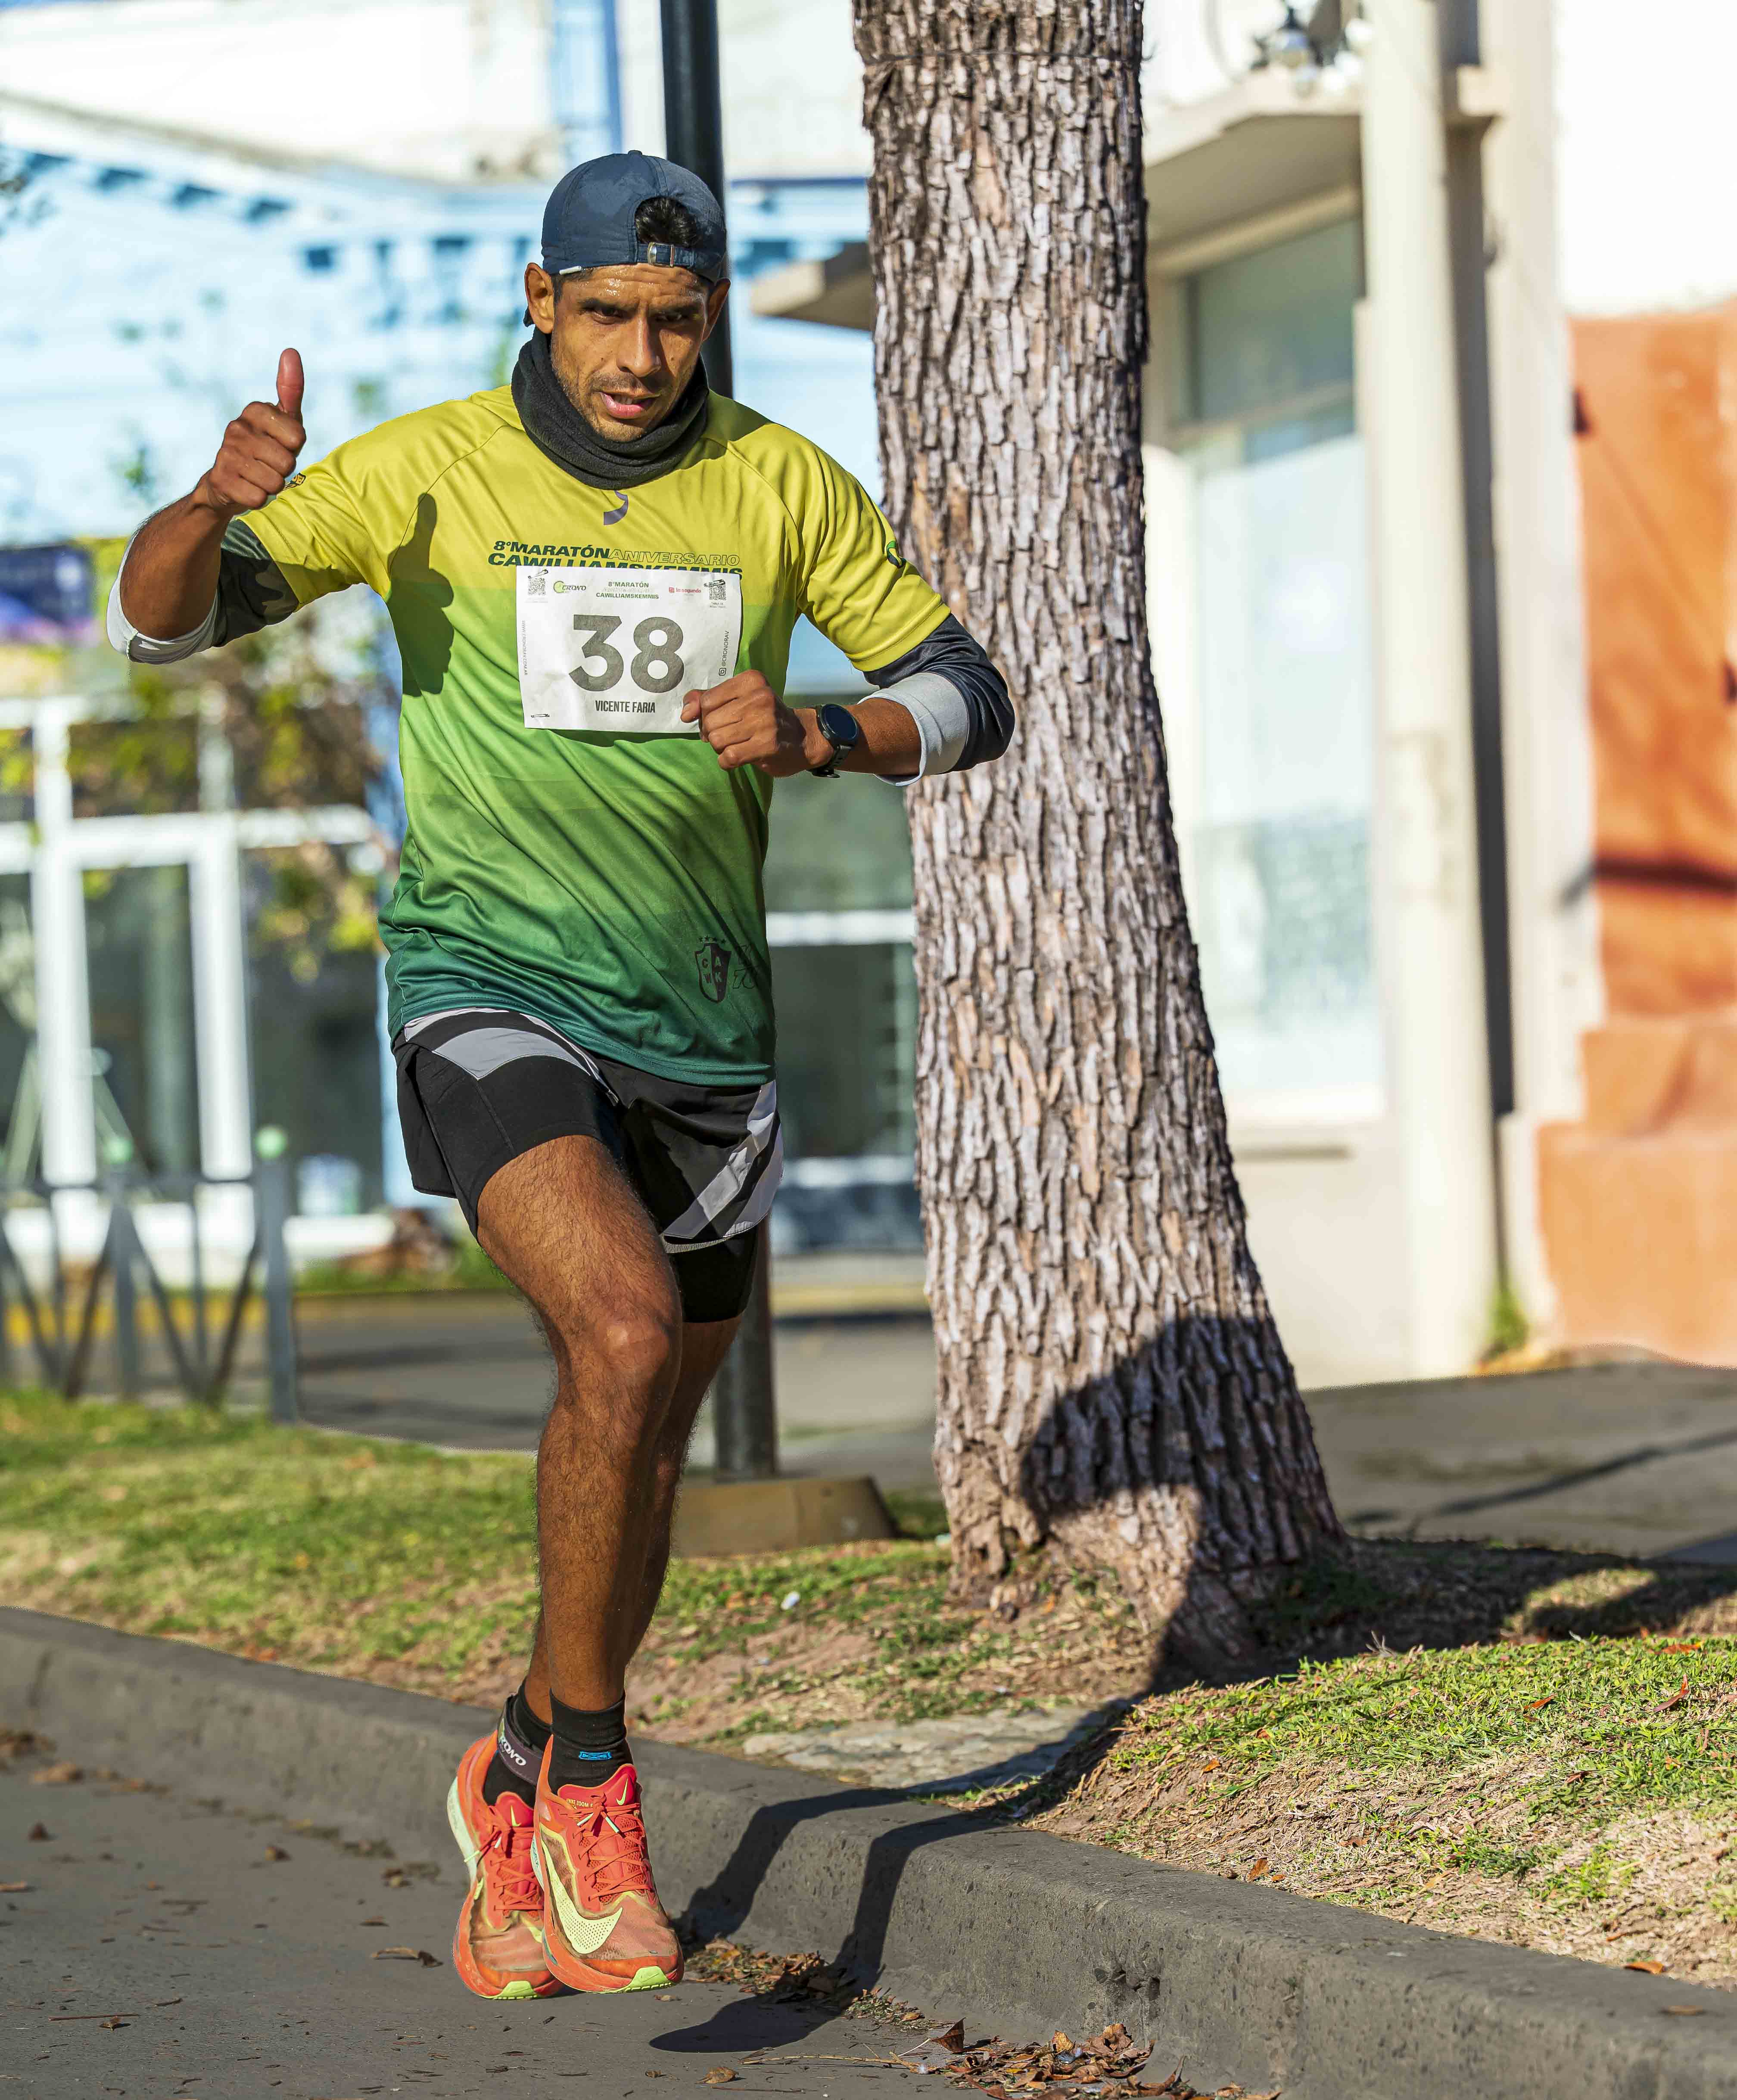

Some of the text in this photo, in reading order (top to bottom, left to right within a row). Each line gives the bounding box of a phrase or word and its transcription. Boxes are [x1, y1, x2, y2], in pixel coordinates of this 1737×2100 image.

[569, 614, 684, 693] 38
[595, 700, 656, 713] VICENTE FARIA
